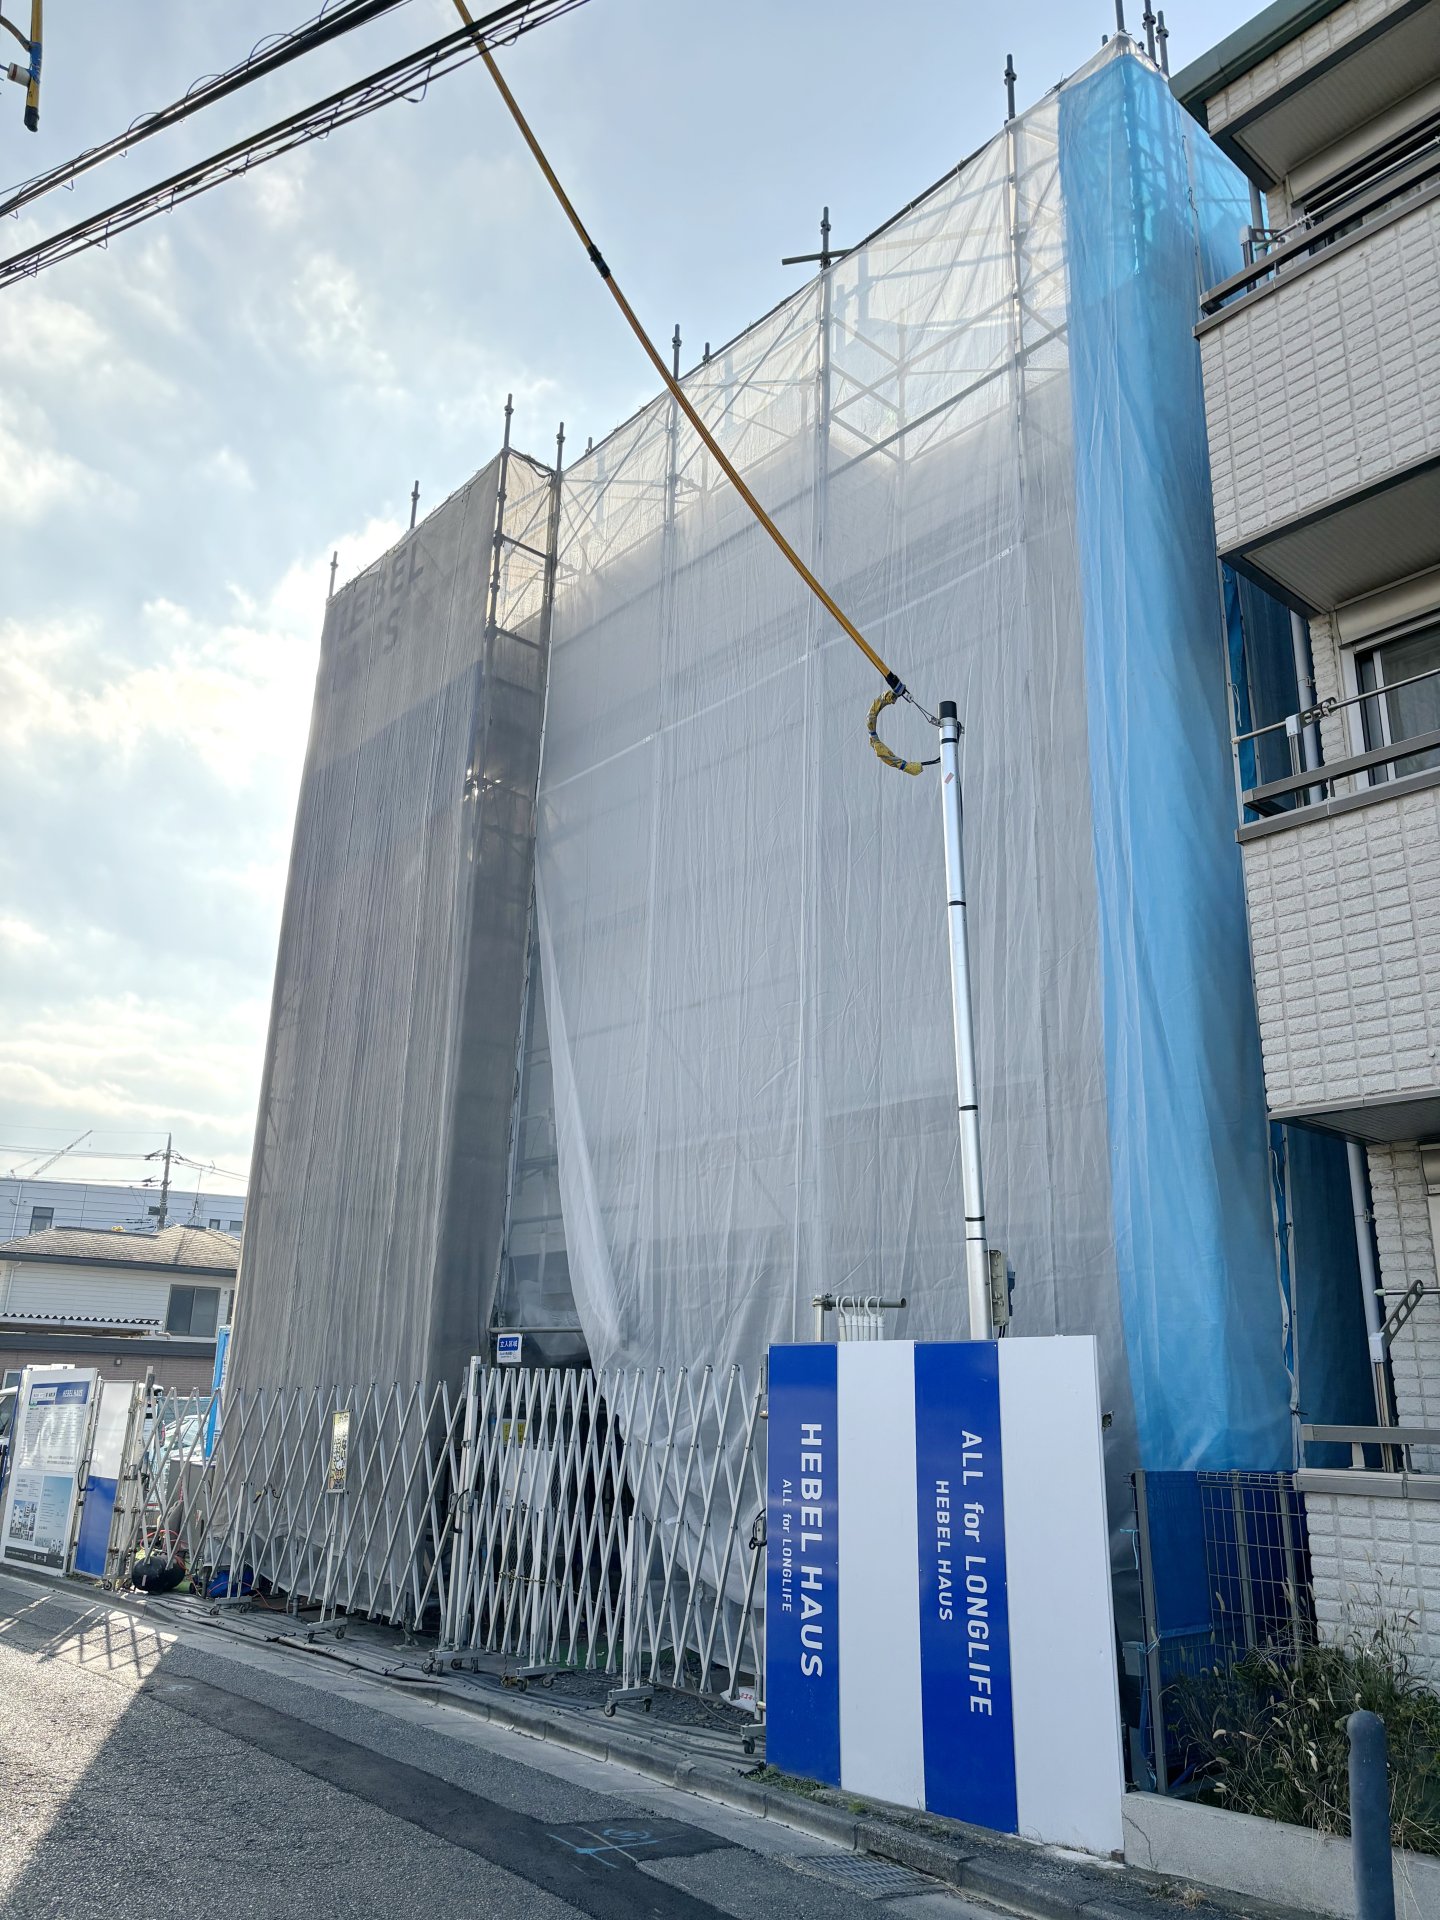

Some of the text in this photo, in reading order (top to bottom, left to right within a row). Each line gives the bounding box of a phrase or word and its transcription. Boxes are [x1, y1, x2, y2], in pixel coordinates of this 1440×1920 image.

[782, 1478, 793, 1612] ALL for LONGLIFE
[800, 1423, 823, 1677] HEBEL HAUS
[935, 1480, 953, 1621] HEBEL HAUS
[962, 1430, 992, 1716] ALL for LONGLIFE
